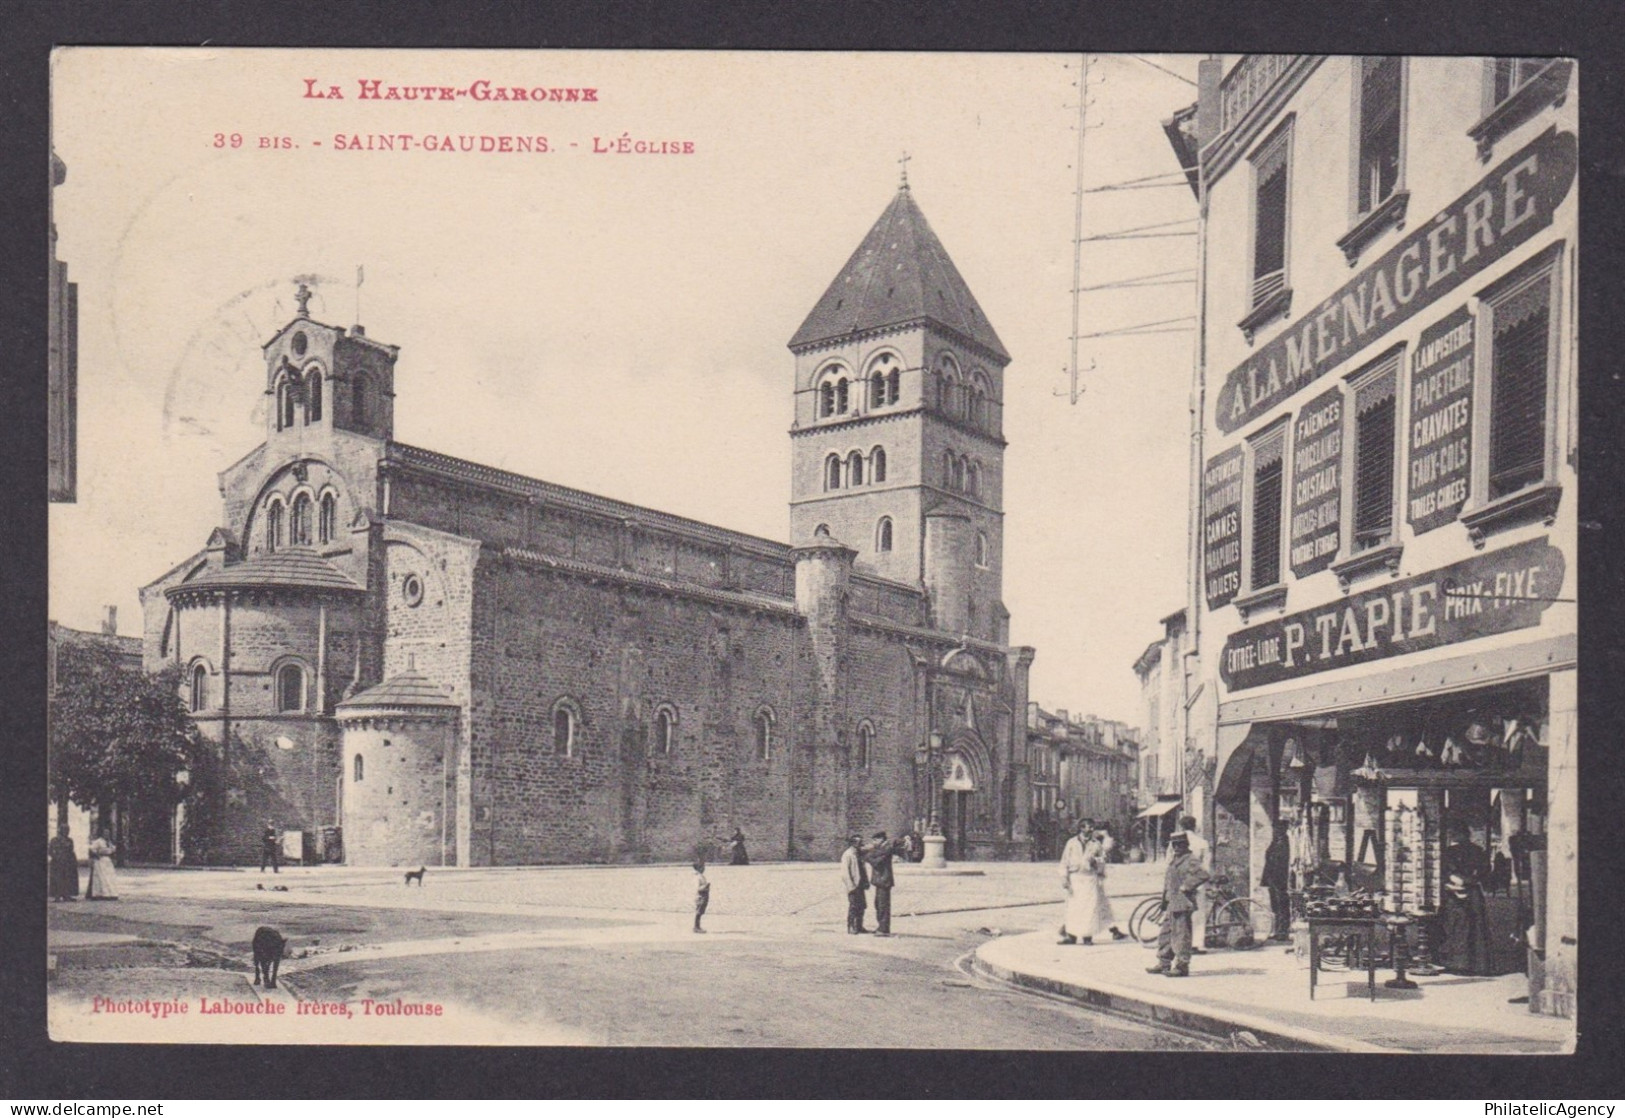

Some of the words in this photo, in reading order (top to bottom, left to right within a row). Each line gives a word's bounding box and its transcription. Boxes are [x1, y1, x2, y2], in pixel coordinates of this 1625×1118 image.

[303, 78, 344, 100] LA
[357, 78, 599, 103] HAUTE-GARONNE
[213, 133, 244, 149] 39
[333, 133, 555, 154] SAINT-GAUDENS.
[592, 132, 695, 155] L'ÉGLISE
[1413, 397, 1468, 449] CRAVATES
[1411, 437, 1468, 491] FAUX-COLS
[1296, 464, 1338, 506] CRISTAUX
[1207, 570, 1239, 600] JOUETS
[1316, 582, 1437, 661] TAPIE
[92, 996, 189, 1019] Phototypie
[199, 997, 286, 1016] Labouche
[362, 998, 443, 1017] Toulouse
